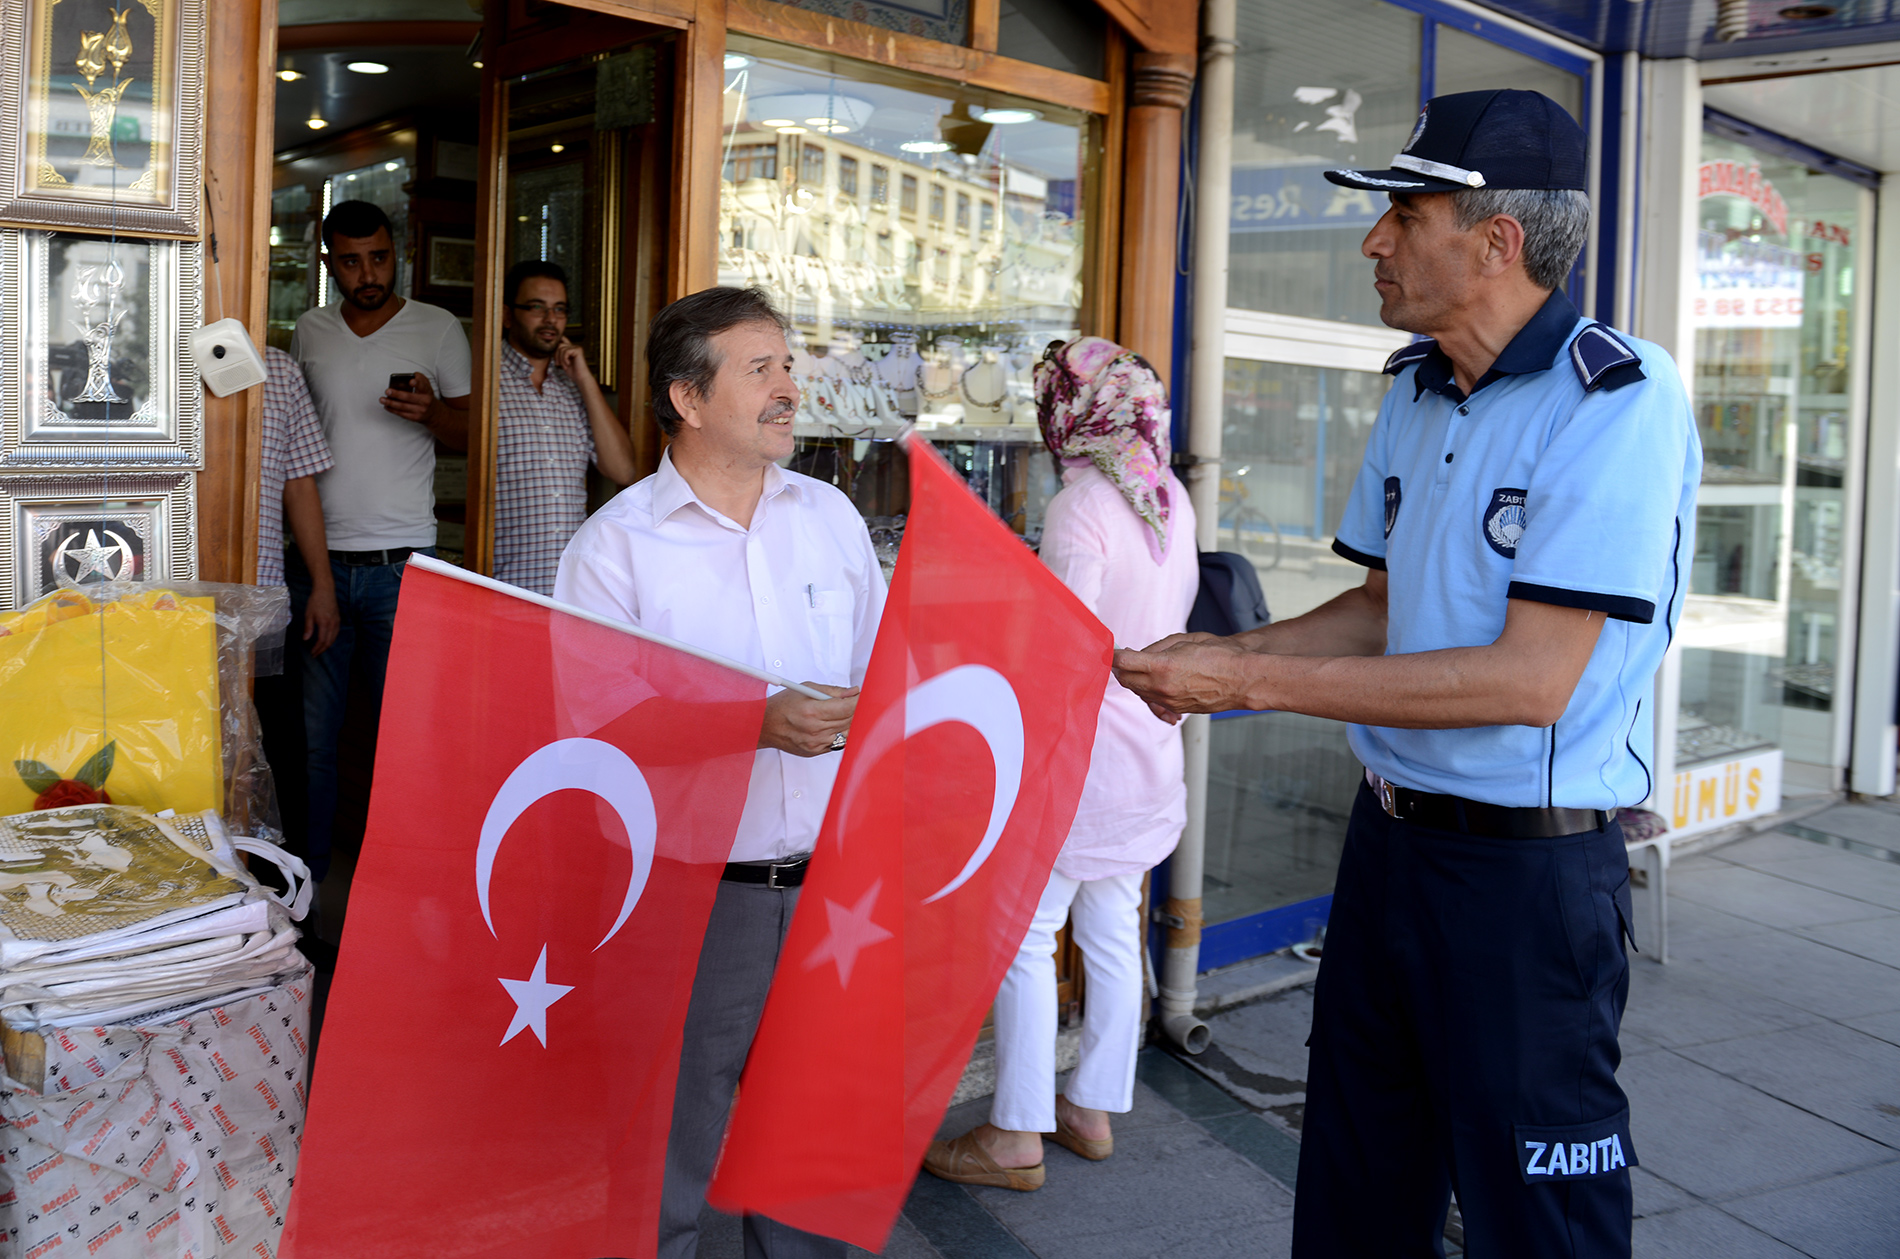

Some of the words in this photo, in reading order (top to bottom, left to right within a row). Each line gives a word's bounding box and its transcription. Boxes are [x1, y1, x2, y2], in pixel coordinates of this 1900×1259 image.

[1697, 157, 1788, 237] RMAĞAN
[1499, 494, 1527, 504] ZABIT
[246, 1025, 271, 1055] necati
[165, 1049, 188, 1075] necati
[212, 1052, 238, 1081] necati
[254, 1080, 278, 1110] necati
[169, 1101, 195, 1132] necati
[213, 1104, 239, 1135] necati
[83, 1119, 112, 1155] necati
[256, 1135, 276, 1163] necati
[1525, 1133, 1627, 1175] ZABITA
[28, 1155, 64, 1184] necati
[217, 1161, 239, 1189] necati
[42, 1185, 78, 1213] necati
[104, 1177, 138, 1204] necati
[253, 1188, 276, 1217] necati
[88, 1225, 122, 1255] necati
[146, 1212, 180, 1243] necati
[215, 1214, 238, 1244] necati
